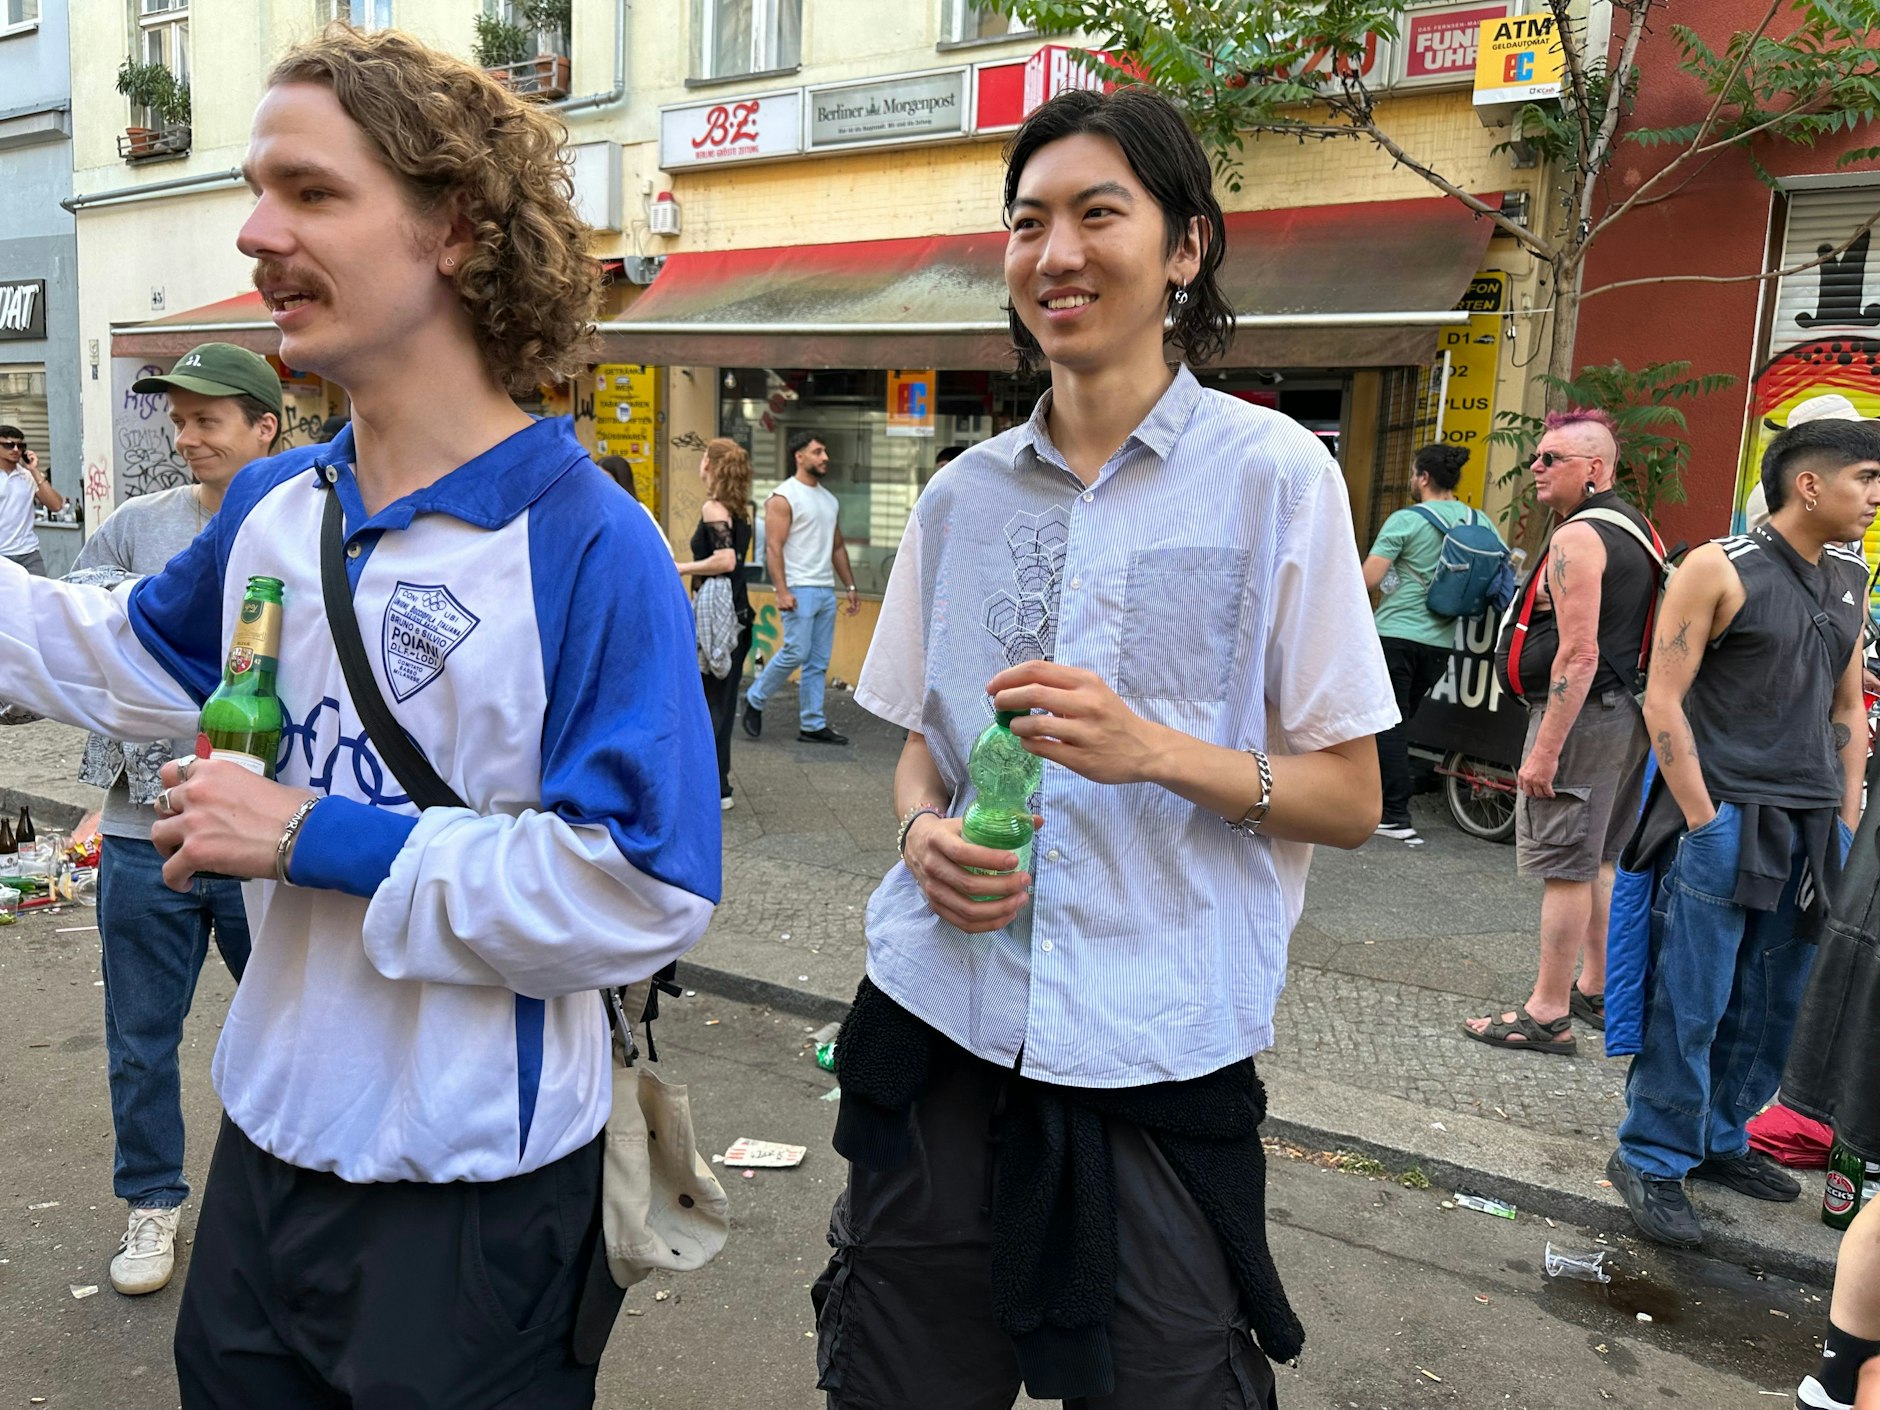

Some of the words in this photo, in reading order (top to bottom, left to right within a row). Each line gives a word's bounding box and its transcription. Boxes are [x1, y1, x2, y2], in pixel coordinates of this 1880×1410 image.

[1494, 18, 1551, 41] ATM
[1492, 38, 1550, 50] GELDAUTOMAT
[817, 103, 864, 122] Berliner
[882, 92, 955, 116] Morgenpost
[1452, 299, 1495, 310] RTEN
[1447, 332, 1470, 345] D1
[402, 590, 418, 602] CONI
[390, 613, 414, 631] BRUNO
[421, 629, 446, 648] SILVIO
[391, 626, 439, 659] POIANI
[397, 658, 423, 673] COMITATO
[399, 665, 418, 676] BASSO
[393, 668, 421, 684] MILANESE
[1826, 1187, 1855, 1201] ECK'S
